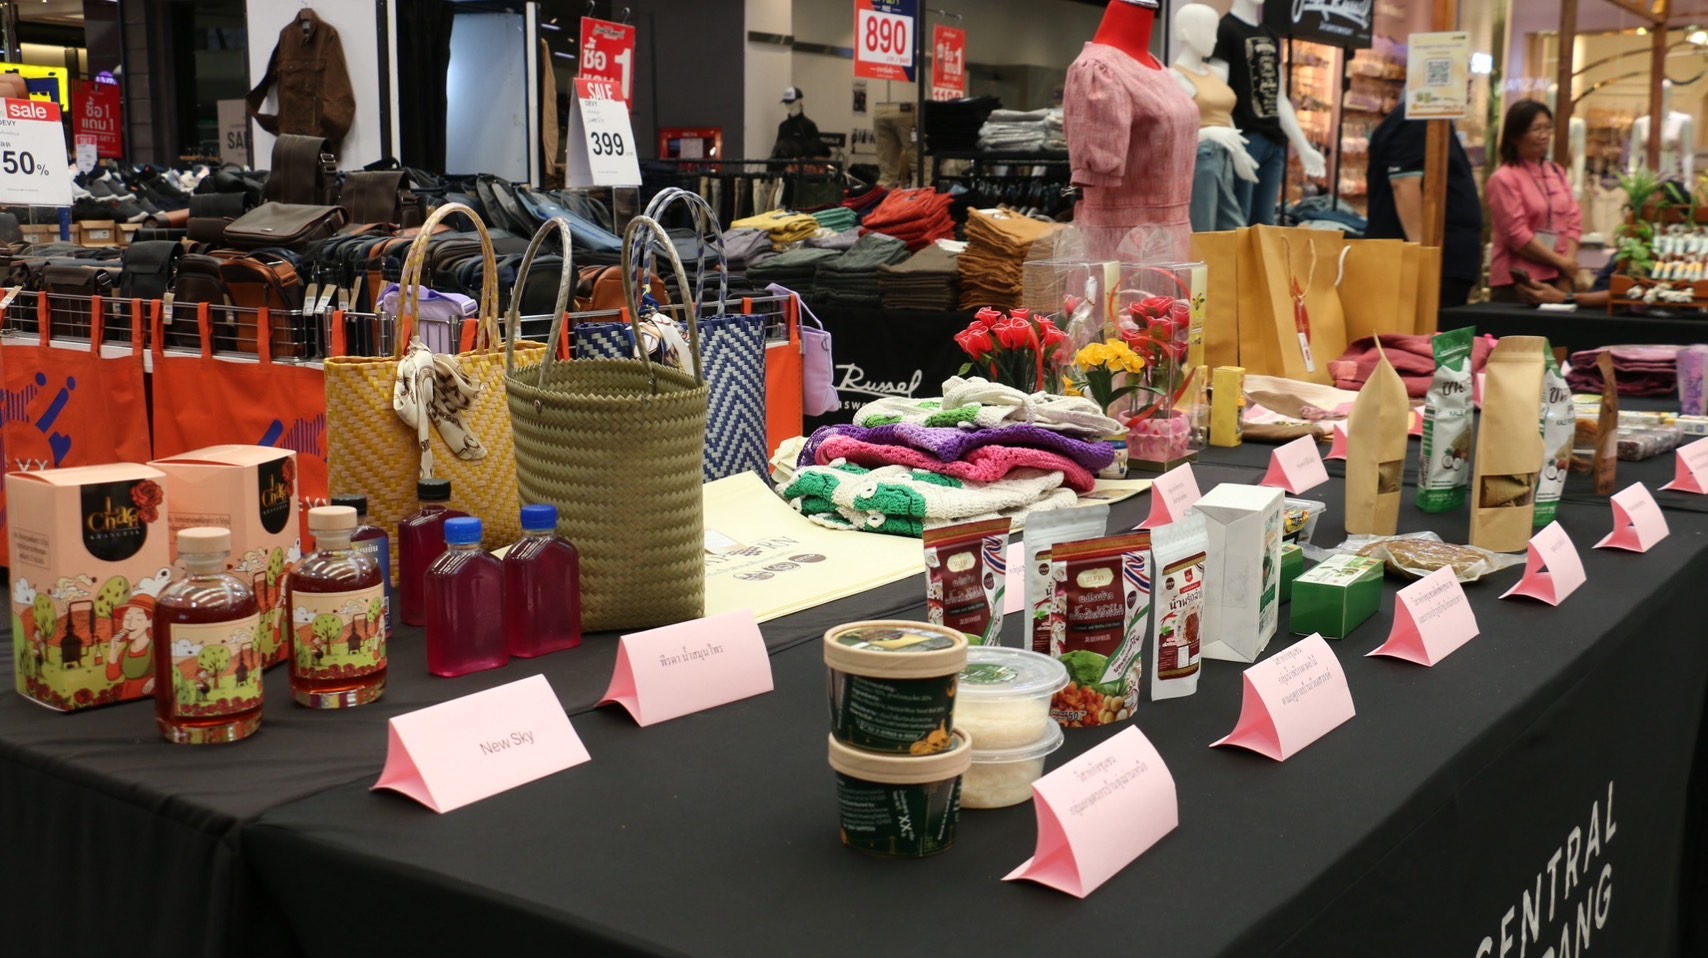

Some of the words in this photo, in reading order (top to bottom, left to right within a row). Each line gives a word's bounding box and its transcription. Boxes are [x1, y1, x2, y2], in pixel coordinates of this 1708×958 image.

[866, 15, 906, 56] 890
[614, 47, 632, 100] 1
[587, 82, 614, 101] SALE
[9, 102, 47, 119] sale
[591, 132, 624, 157] 399
[836, 363, 922, 399] Russel
[480, 739, 511, 756] New
[509, 730, 535, 746] Sky
